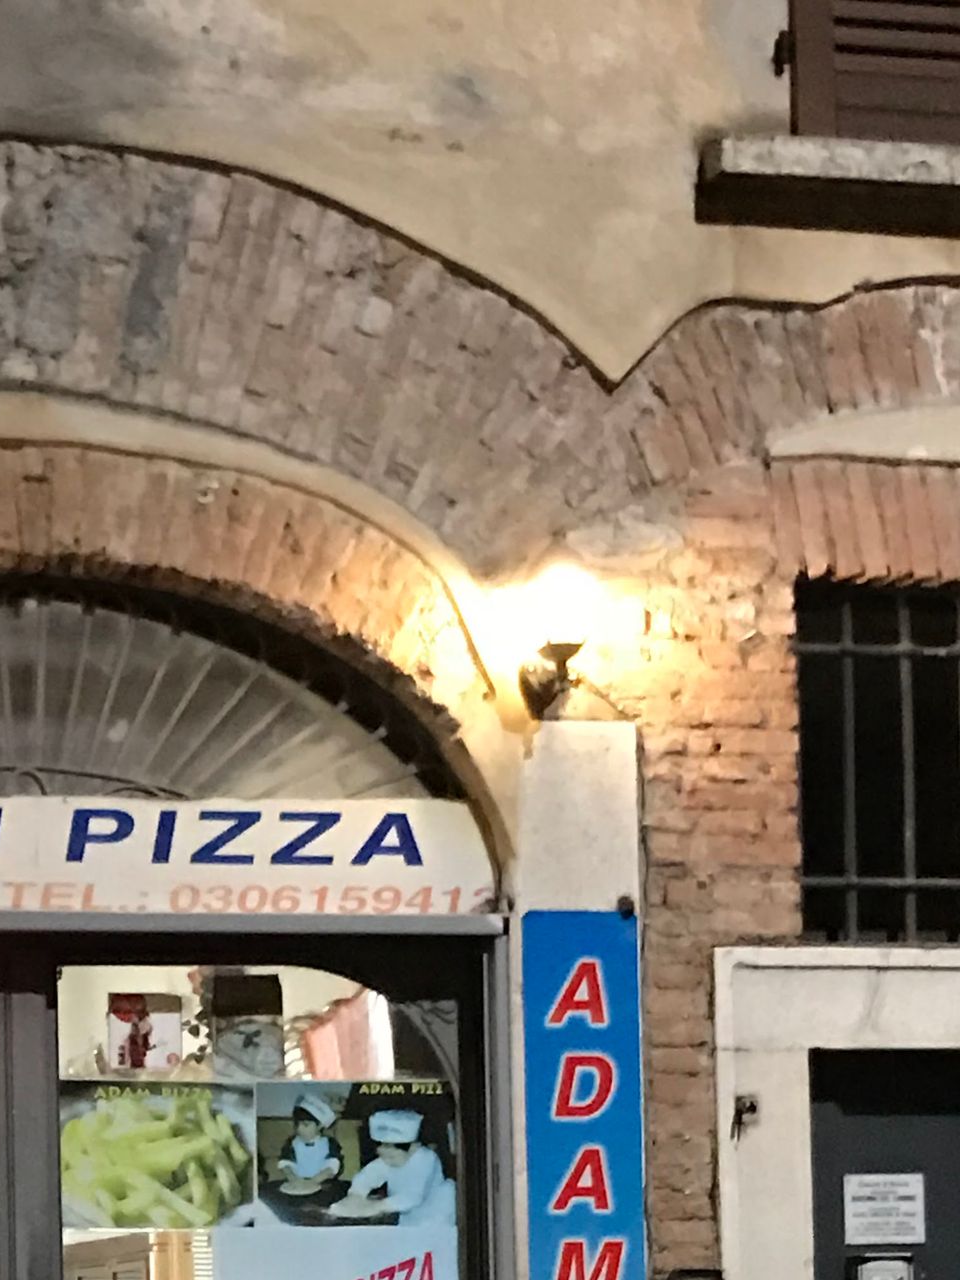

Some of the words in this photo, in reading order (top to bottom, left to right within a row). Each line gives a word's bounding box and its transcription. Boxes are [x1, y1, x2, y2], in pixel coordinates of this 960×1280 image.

[65, 808, 424, 867] PIZZA
[94, 1085, 151, 1098] ADAM
[358, 1083, 405, 1095] ADAM
